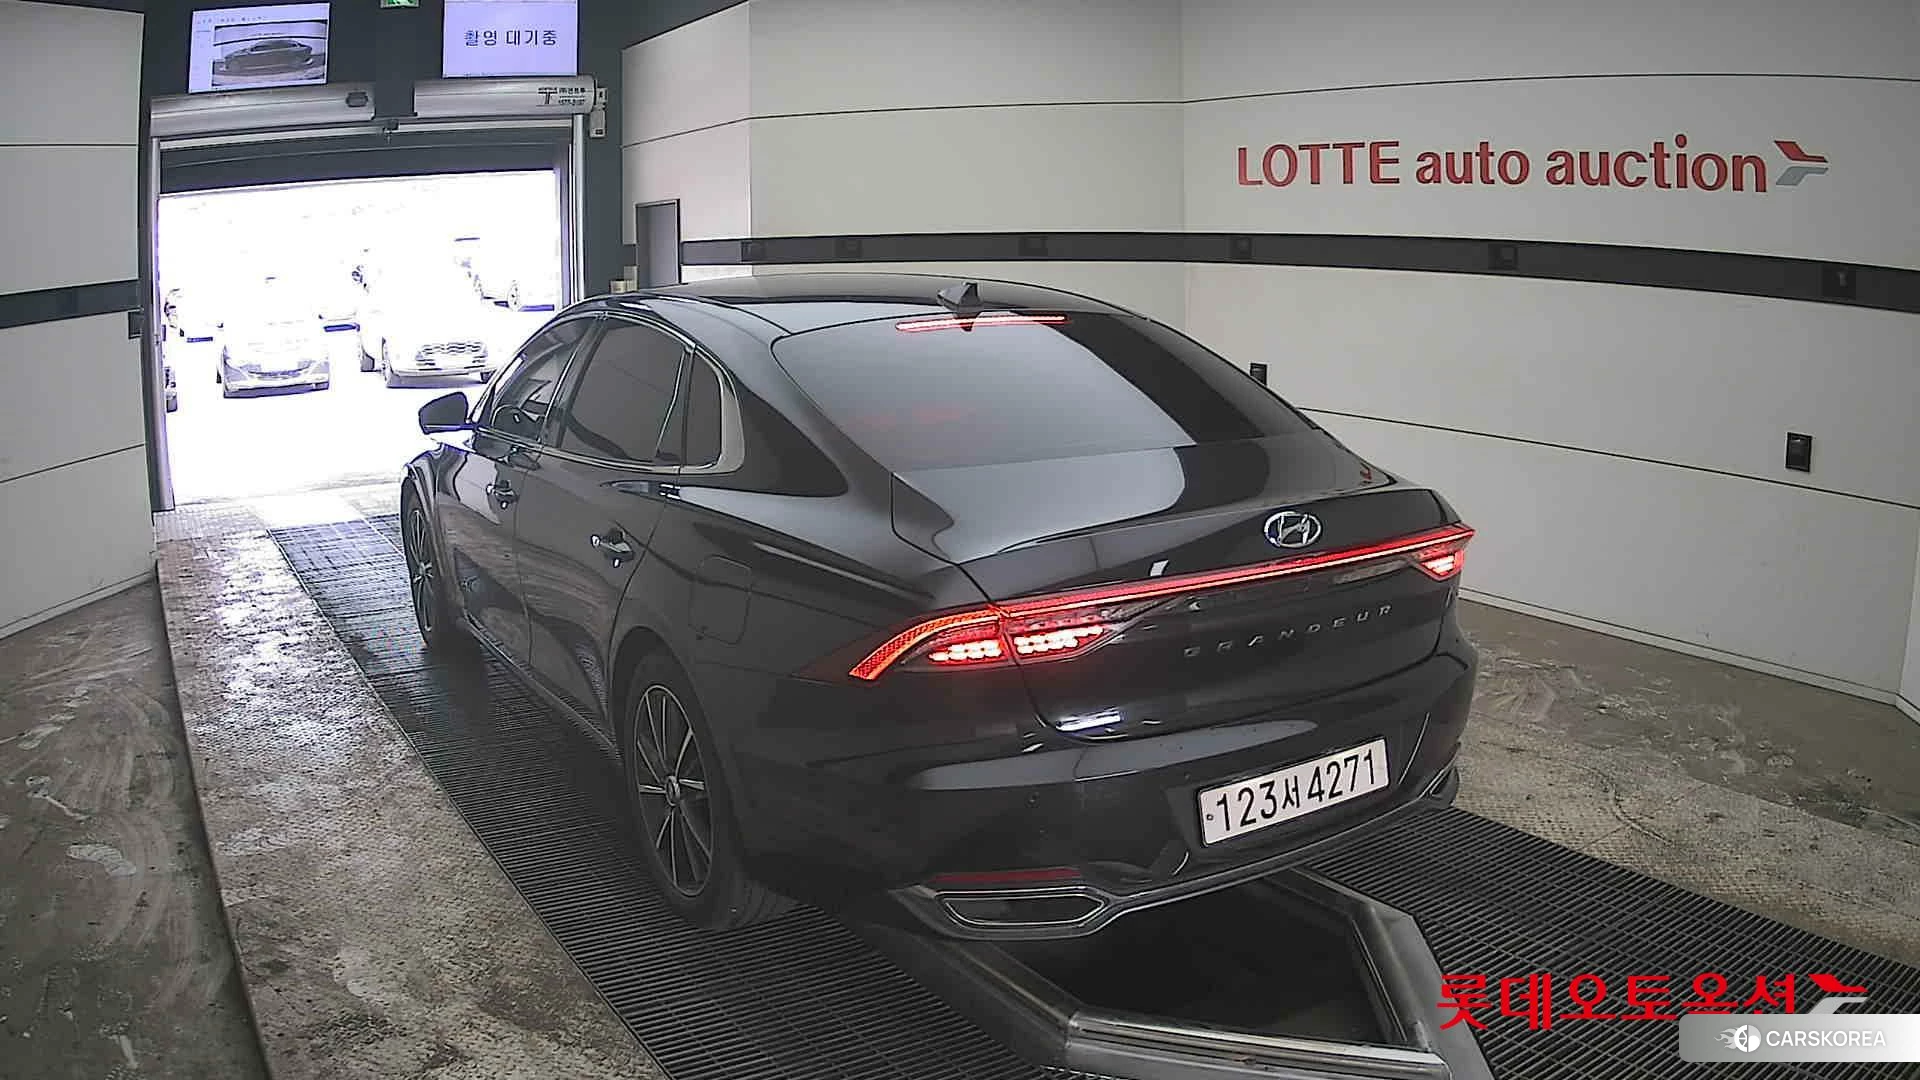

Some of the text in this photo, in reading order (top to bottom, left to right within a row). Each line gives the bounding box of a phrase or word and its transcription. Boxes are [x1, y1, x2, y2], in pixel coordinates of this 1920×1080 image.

[464, 30, 557, 46] 촬영 대기중
[1236, 133, 1769, 194] LOTTE auto auction
[1183, 604, 1391, 657] GRANDEUR
